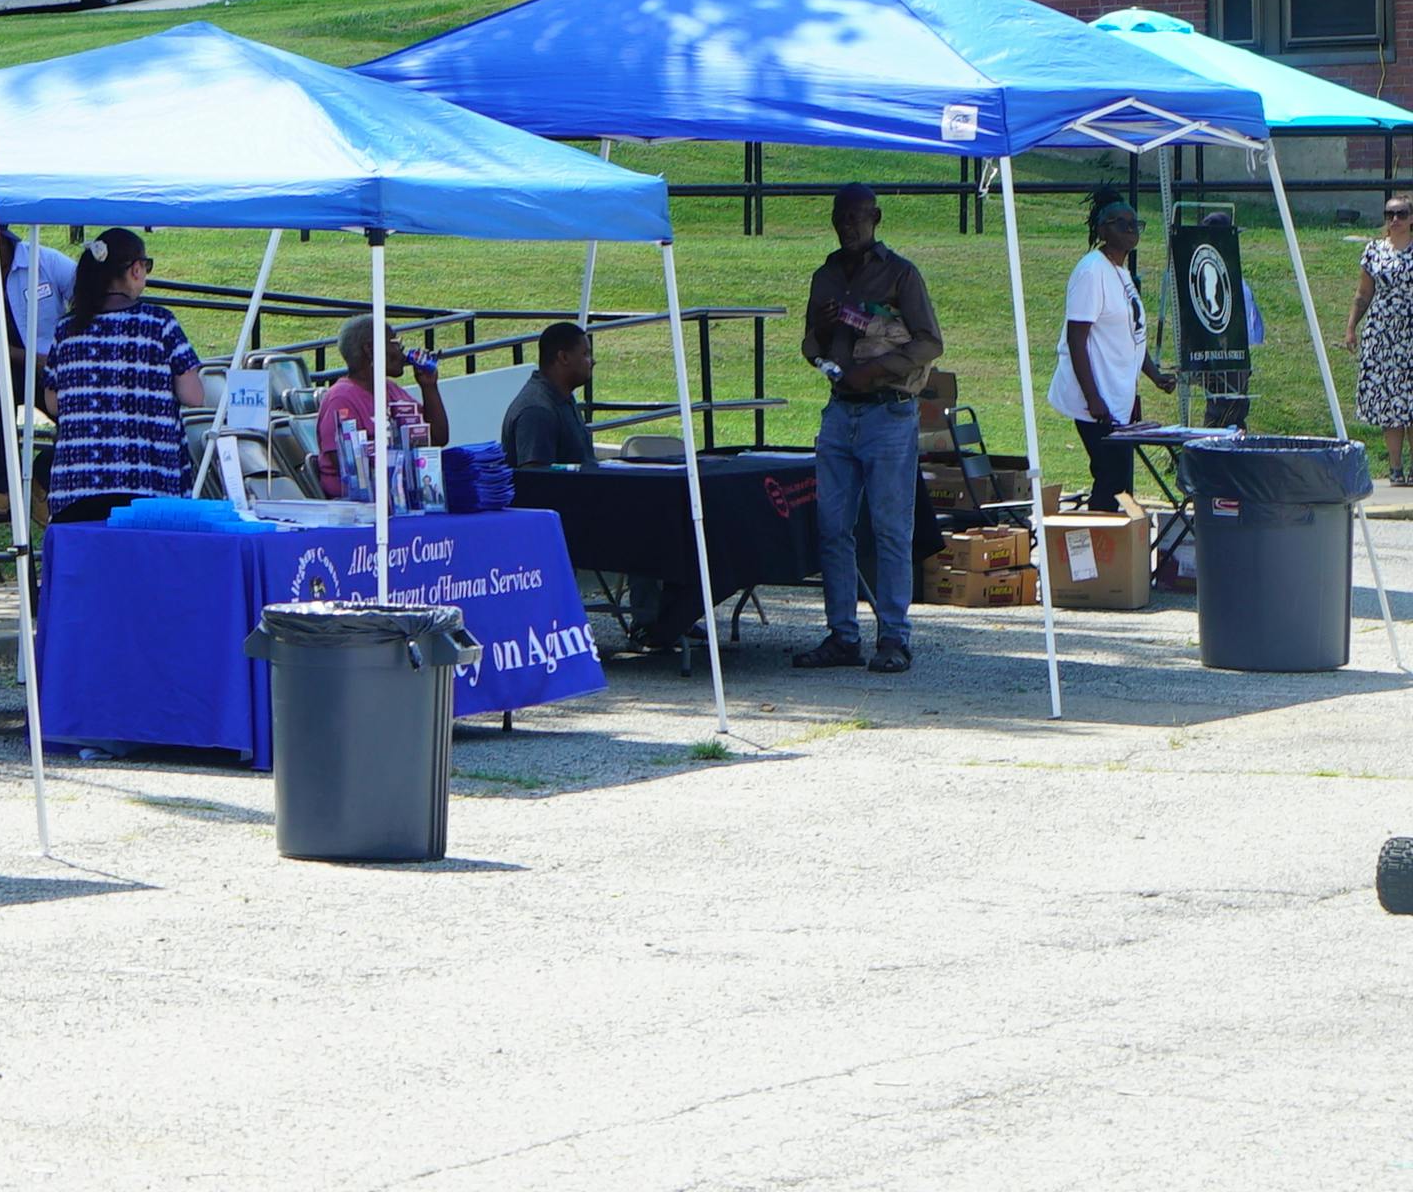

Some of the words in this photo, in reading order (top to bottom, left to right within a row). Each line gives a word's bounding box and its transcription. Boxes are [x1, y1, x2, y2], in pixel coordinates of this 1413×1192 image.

[230, 388, 265, 407] Link
[489, 565, 543, 595] Services
[492, 639, 523, 672] on
